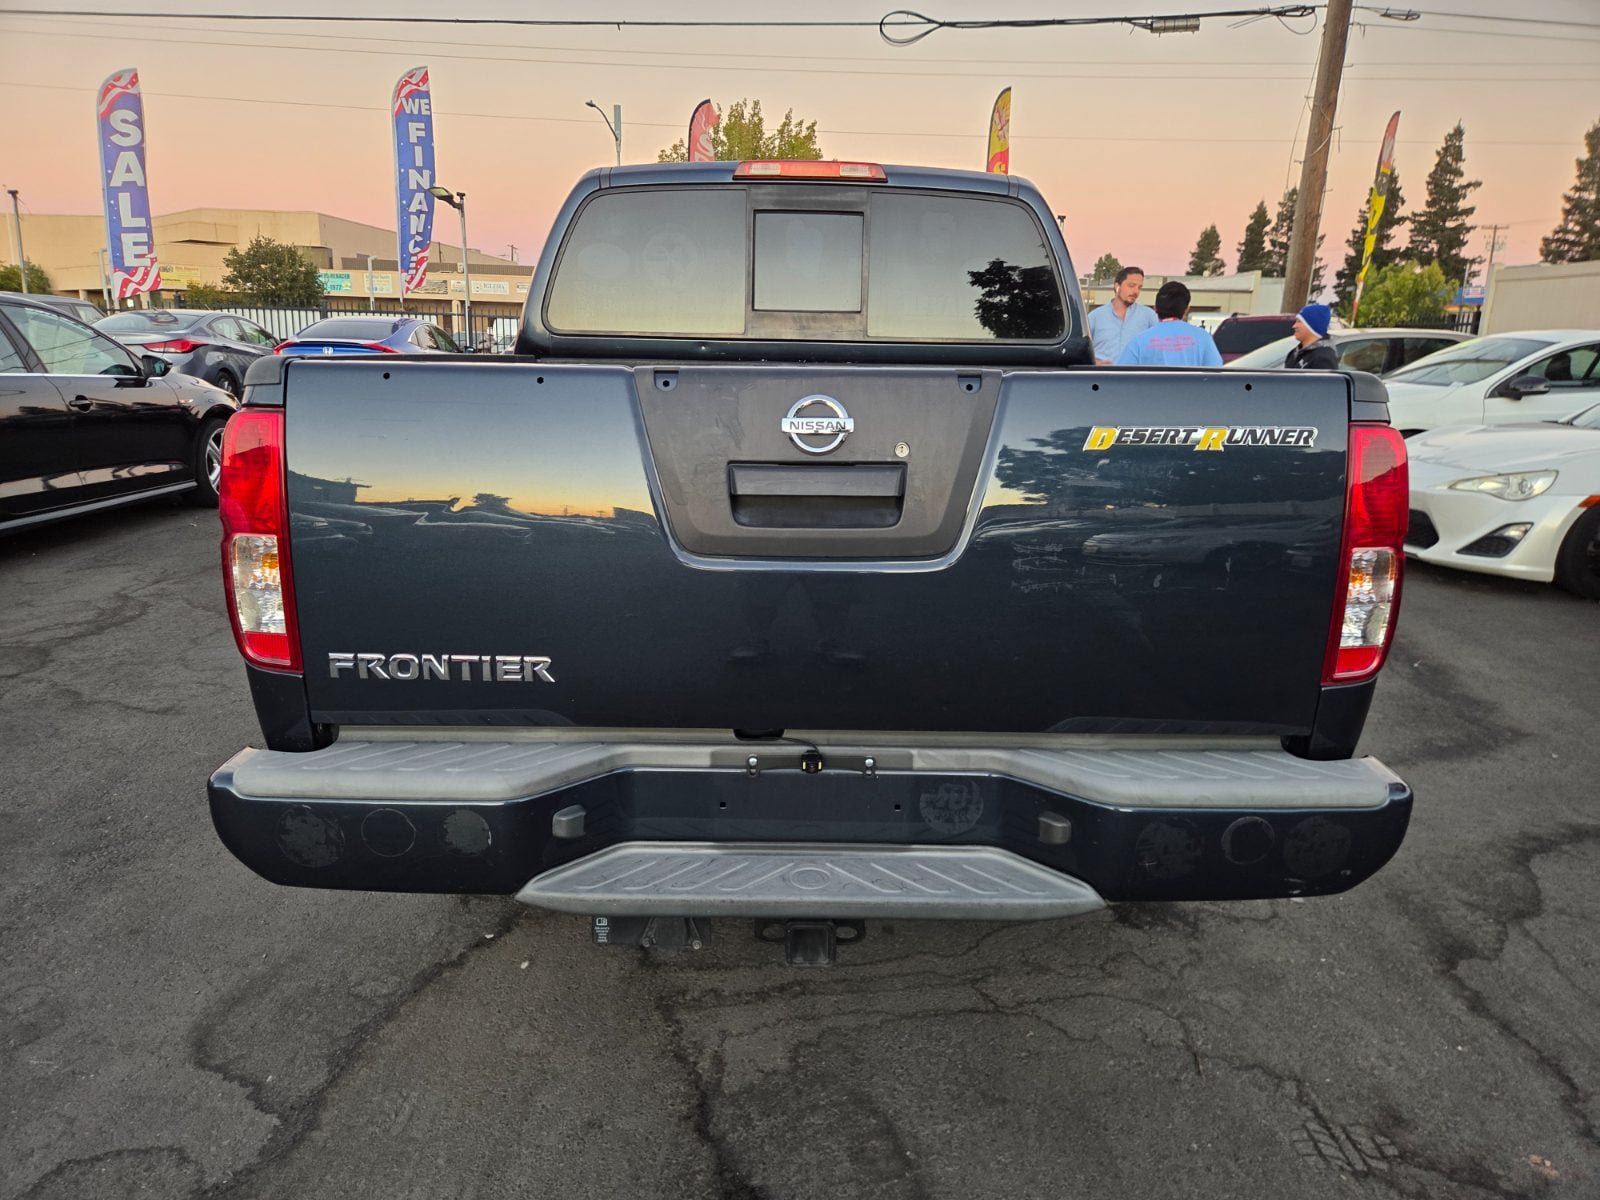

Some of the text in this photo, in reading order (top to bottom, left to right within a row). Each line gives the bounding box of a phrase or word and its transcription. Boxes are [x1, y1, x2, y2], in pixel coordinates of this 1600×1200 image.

[402, 98, 431, 115] WE
[109, 109, 151, 267] SALE
[789, 421, 846, 431] NISSAN
[1083, 426, 1319, 451] DESERT RUNNER
[328, 652, 556, 683] FRONTIER
